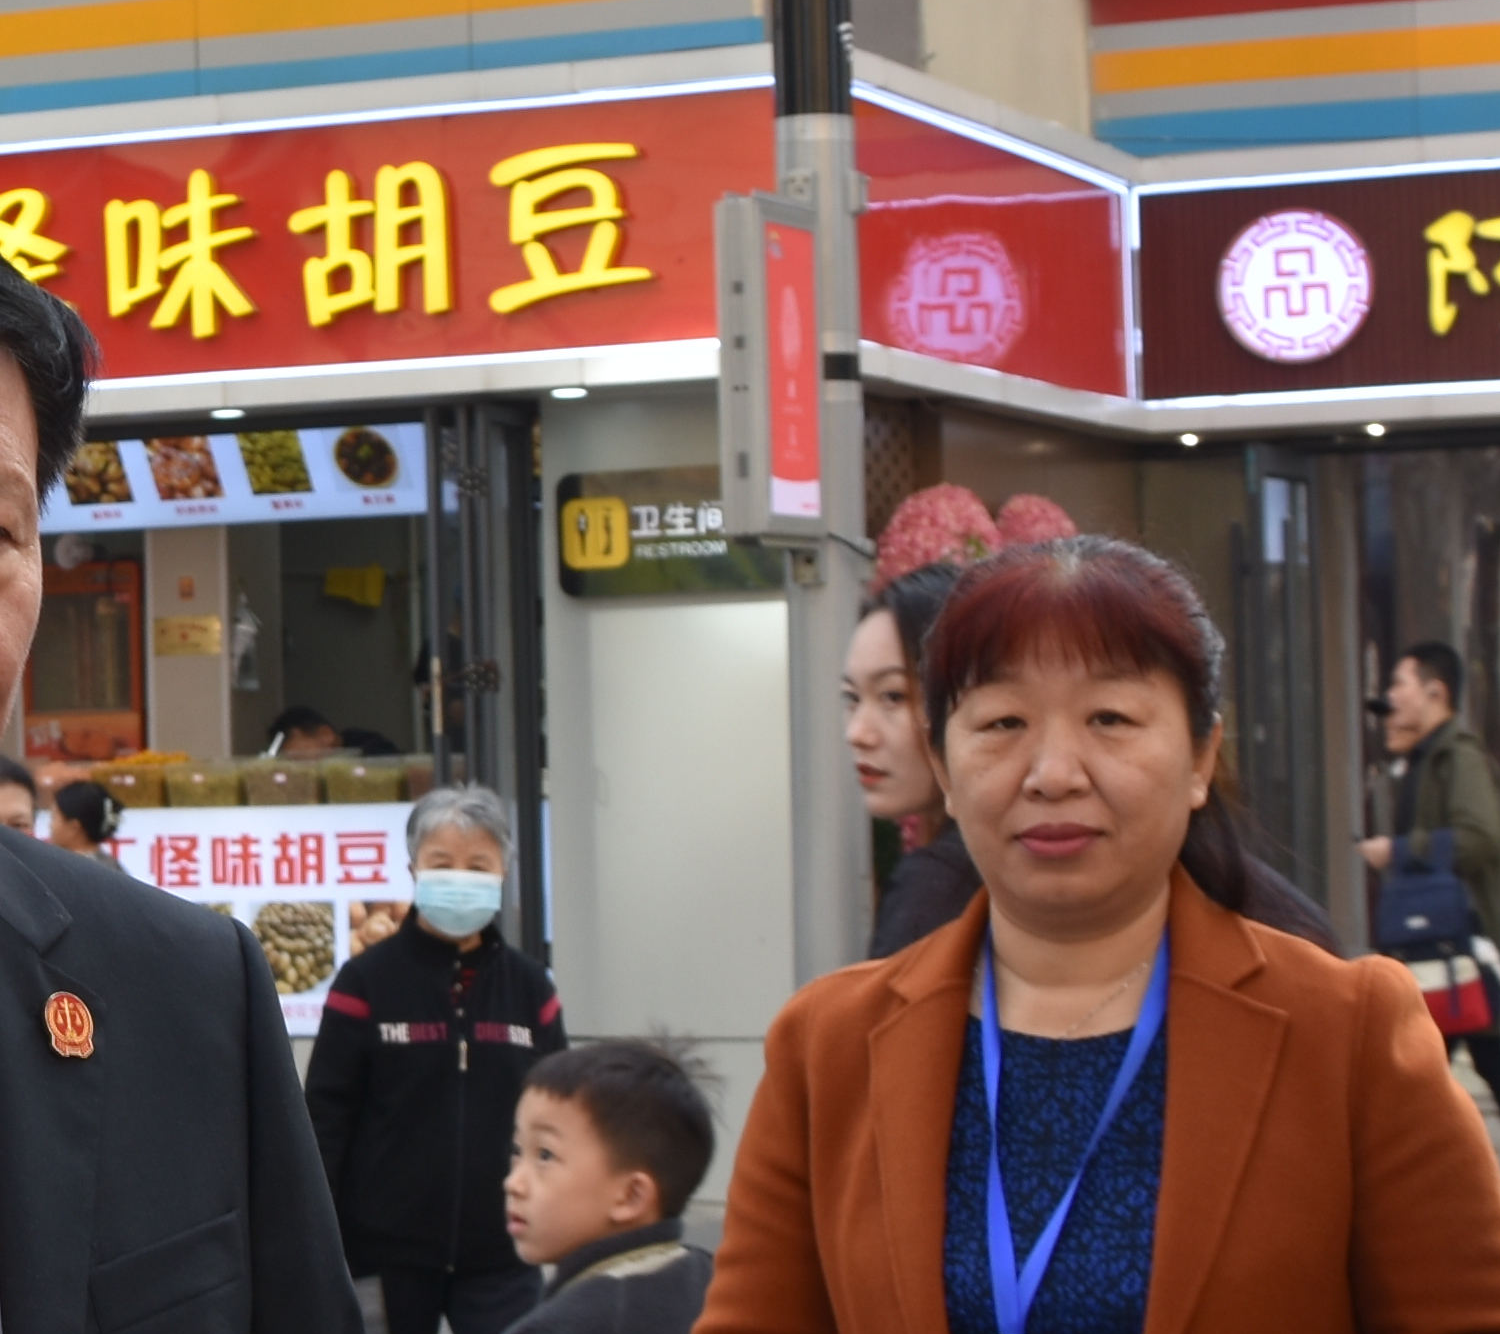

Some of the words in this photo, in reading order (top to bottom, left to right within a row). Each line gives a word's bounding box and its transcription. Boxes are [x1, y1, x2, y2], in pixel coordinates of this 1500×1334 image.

[631, 501, 726, 537] 卫生间
[634, 539, 728, 559] RESTROOM
